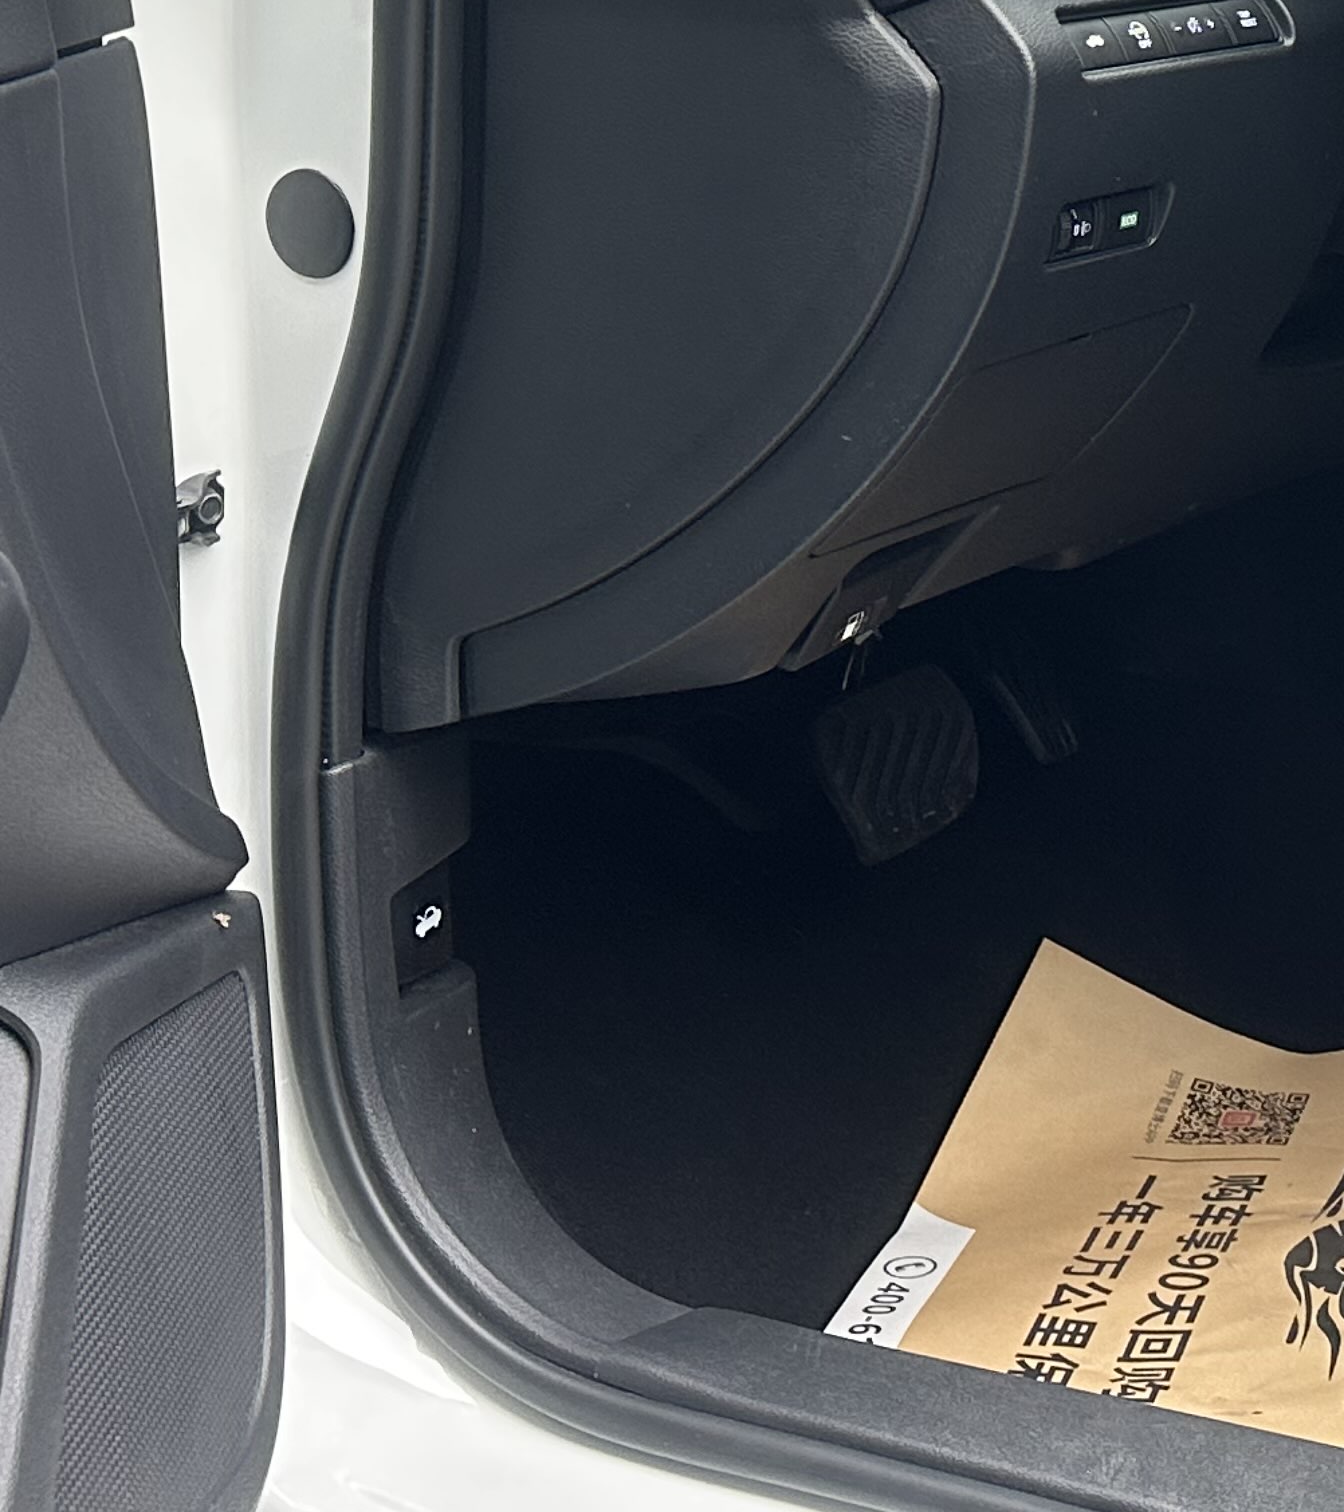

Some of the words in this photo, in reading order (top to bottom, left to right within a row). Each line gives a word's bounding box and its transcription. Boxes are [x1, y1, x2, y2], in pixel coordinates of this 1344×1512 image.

[848, 1282, 910, 1345] 400-6
[1006, 1174, 1164, 1387] 一年三万公里保
[1100, 1174, 1268, 1403] 购车享90天回购
